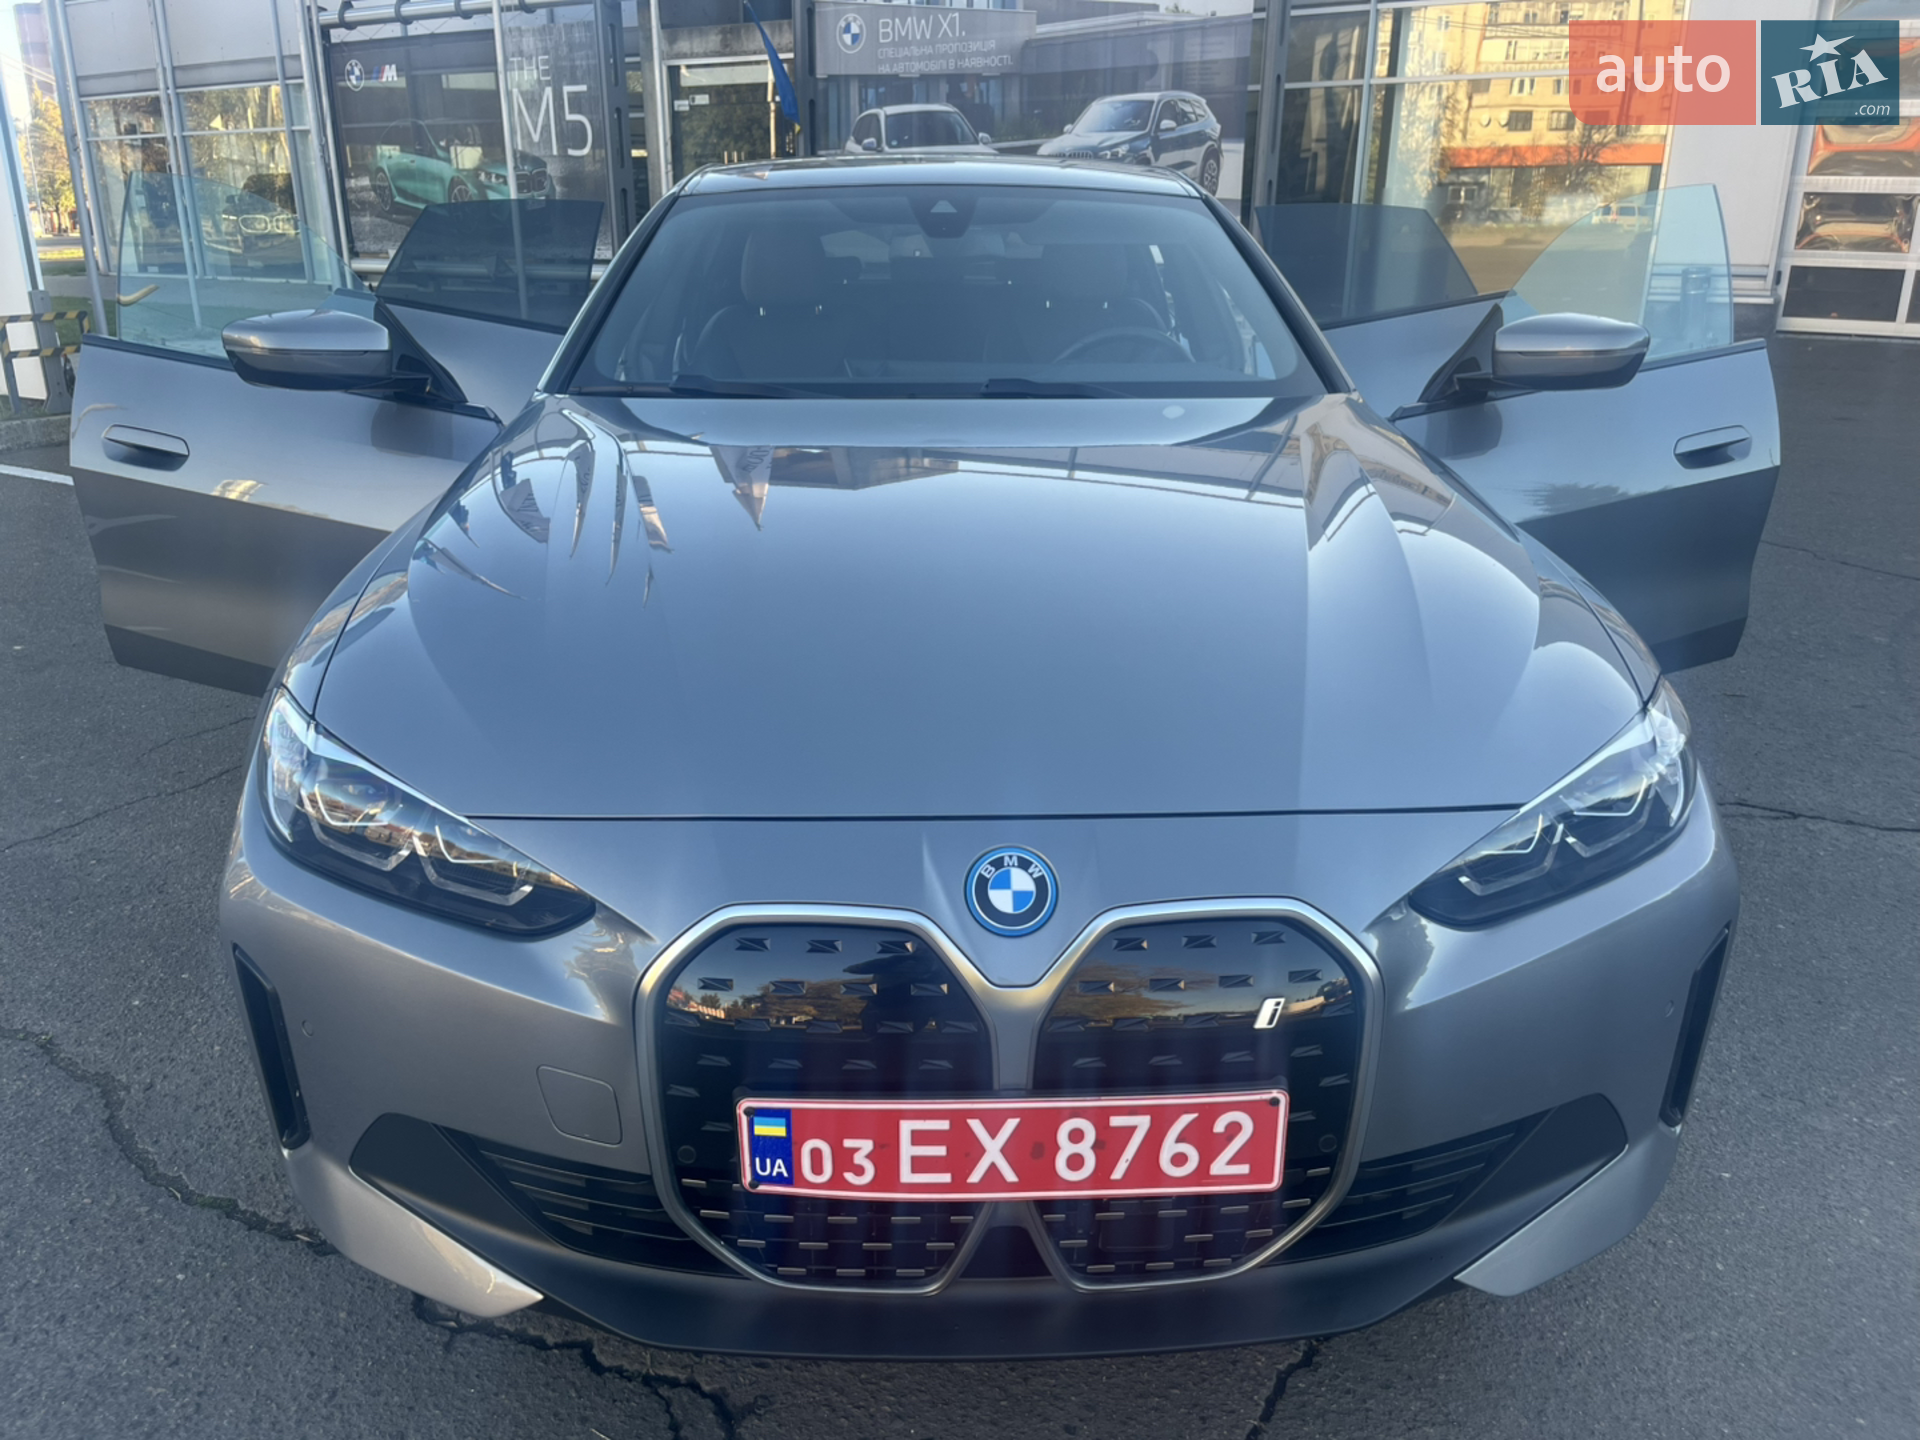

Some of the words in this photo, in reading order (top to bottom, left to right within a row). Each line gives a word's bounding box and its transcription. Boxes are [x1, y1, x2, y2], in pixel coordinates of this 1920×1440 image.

[879, 15, 933, 43] BMW
[938, 12, 966, 38] X1.
[935, 40, 996, 55] ПРОПОЗИЦІЯ
[509, 55, 551, 82] THE
[878, 64, 890, 73] НА
[892, 59, 947, 73] АВТОМОБІЛІ
[948, 58, 956, 70] В
[512, 84, 593, 156] M5
[980, 855, 1042, 878] BMW
[800, 1138, 876, 1186] 03
[899, 1117, 1021, 1183] EX
[1055, 1110, 1255, 1182] 8762
[755, 1157, 788, 1178] UA
